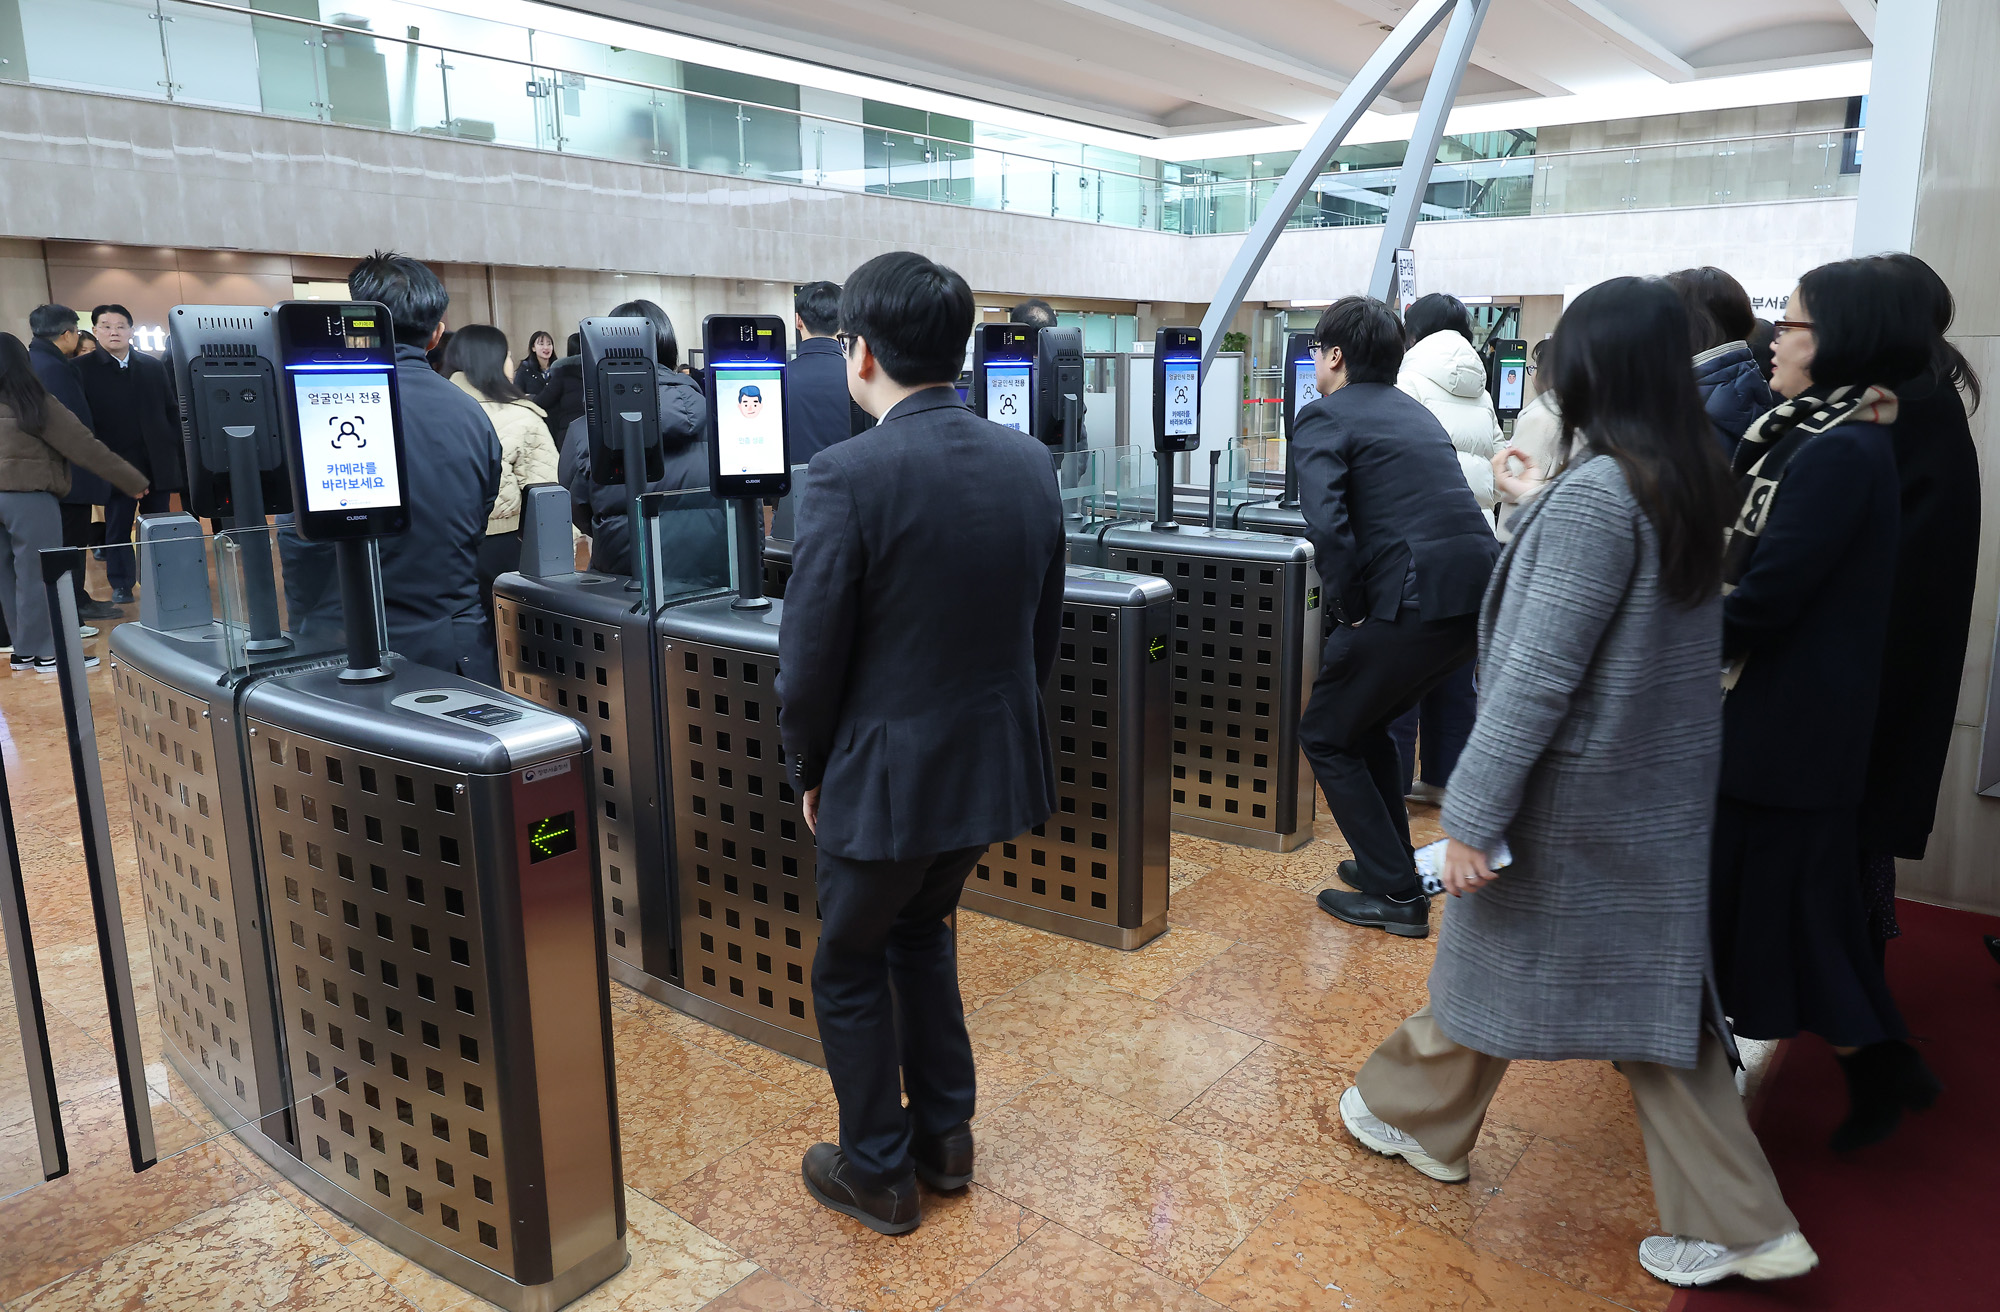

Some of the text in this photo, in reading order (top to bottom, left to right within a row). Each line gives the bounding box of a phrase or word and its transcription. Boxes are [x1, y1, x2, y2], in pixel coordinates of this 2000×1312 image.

[129, 325, 166, 351] tt
[991, 379, 1025, 388] 얼굴인식 전용
[308, 391, 381, 405] 얼굴인식 전용
[1172, 410, 1190, 418] 카메라를
[1169, 418, 1192, 426] 바라보세요
[326, 462, 377, 476] 카메라를
[322, 477, 385, 491] 바라보세요
